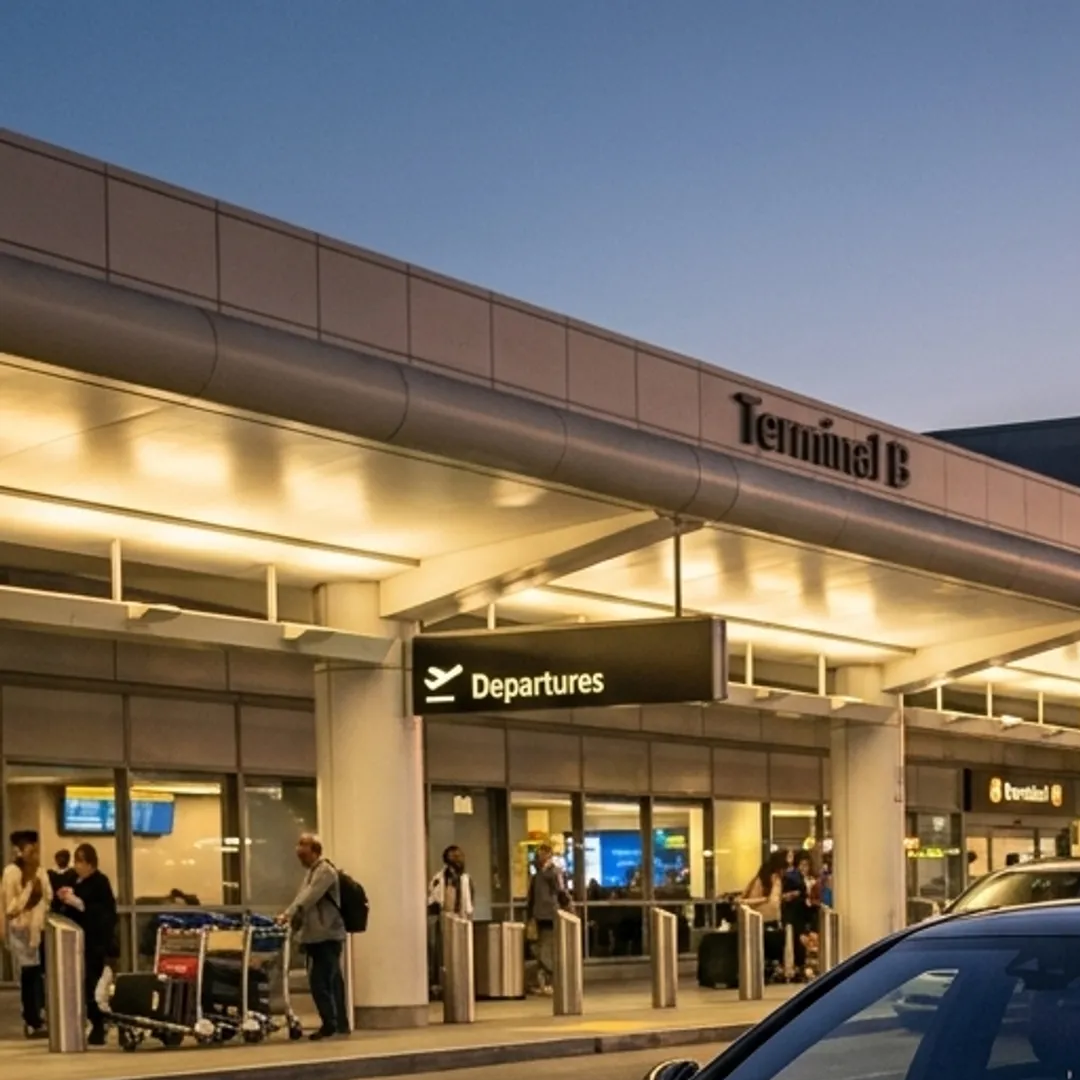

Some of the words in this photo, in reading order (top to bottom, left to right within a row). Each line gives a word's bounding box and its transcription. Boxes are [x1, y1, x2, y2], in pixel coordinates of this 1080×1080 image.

[732, 392, 880, 481] Terminal
[886, 440, 911, 489] B
[471, 671, 605, 703] Departures
